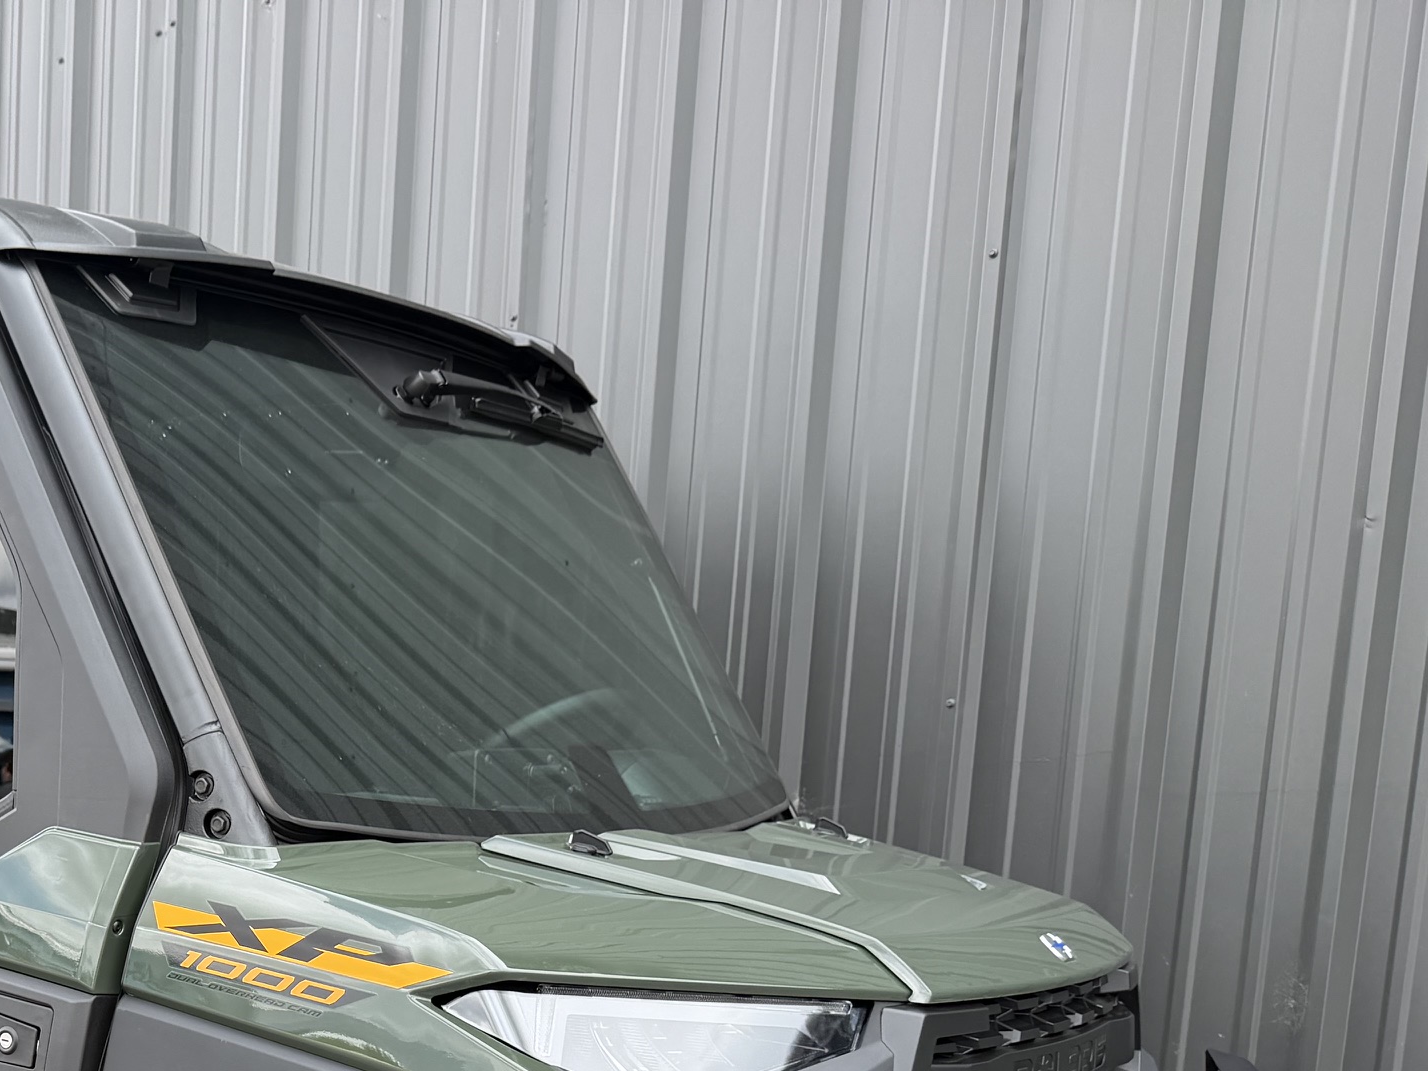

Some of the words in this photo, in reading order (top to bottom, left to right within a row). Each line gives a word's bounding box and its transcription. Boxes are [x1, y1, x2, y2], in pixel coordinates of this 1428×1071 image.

[163, 900, 415, 966] XP
[167, 971, 205, 987] DUAL
[207, 982, 285, 1008] OVERHEAD
[287, 1002, 323, 1017] CAM
[180, 950, 347, 1005] 1000
